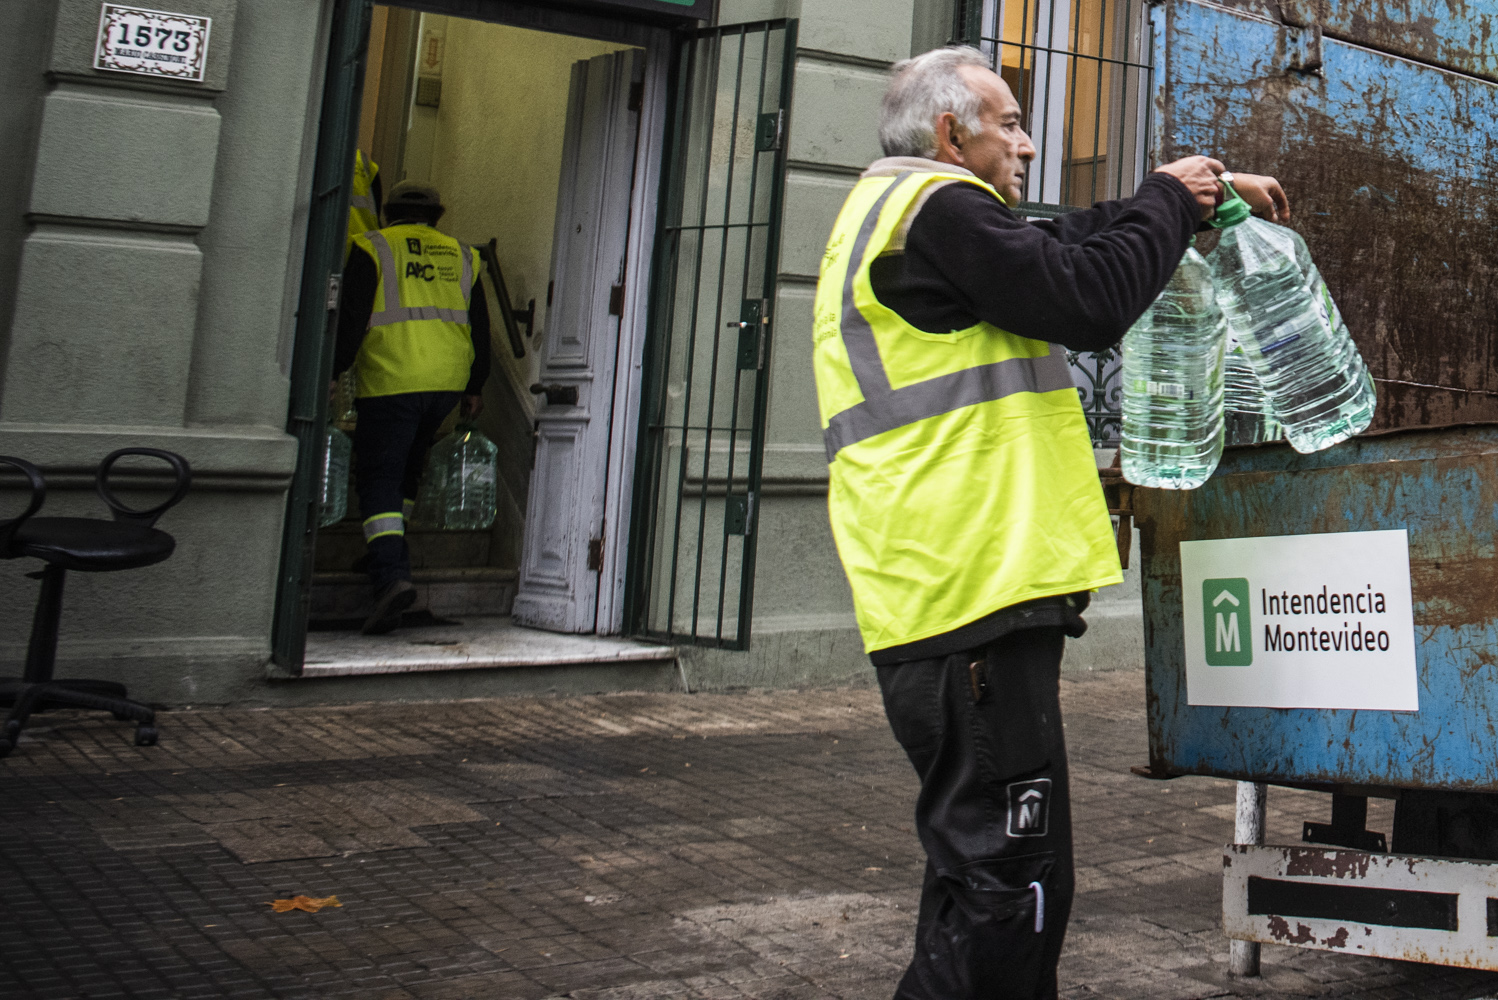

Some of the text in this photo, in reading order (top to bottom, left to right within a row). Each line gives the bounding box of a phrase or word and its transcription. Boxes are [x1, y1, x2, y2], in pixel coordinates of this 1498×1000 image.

[117, 23, 191, 52] 1573
[1262, 584, 1386, 615] Intendencia
[1265, 621, 1390, 652] Montevideo
